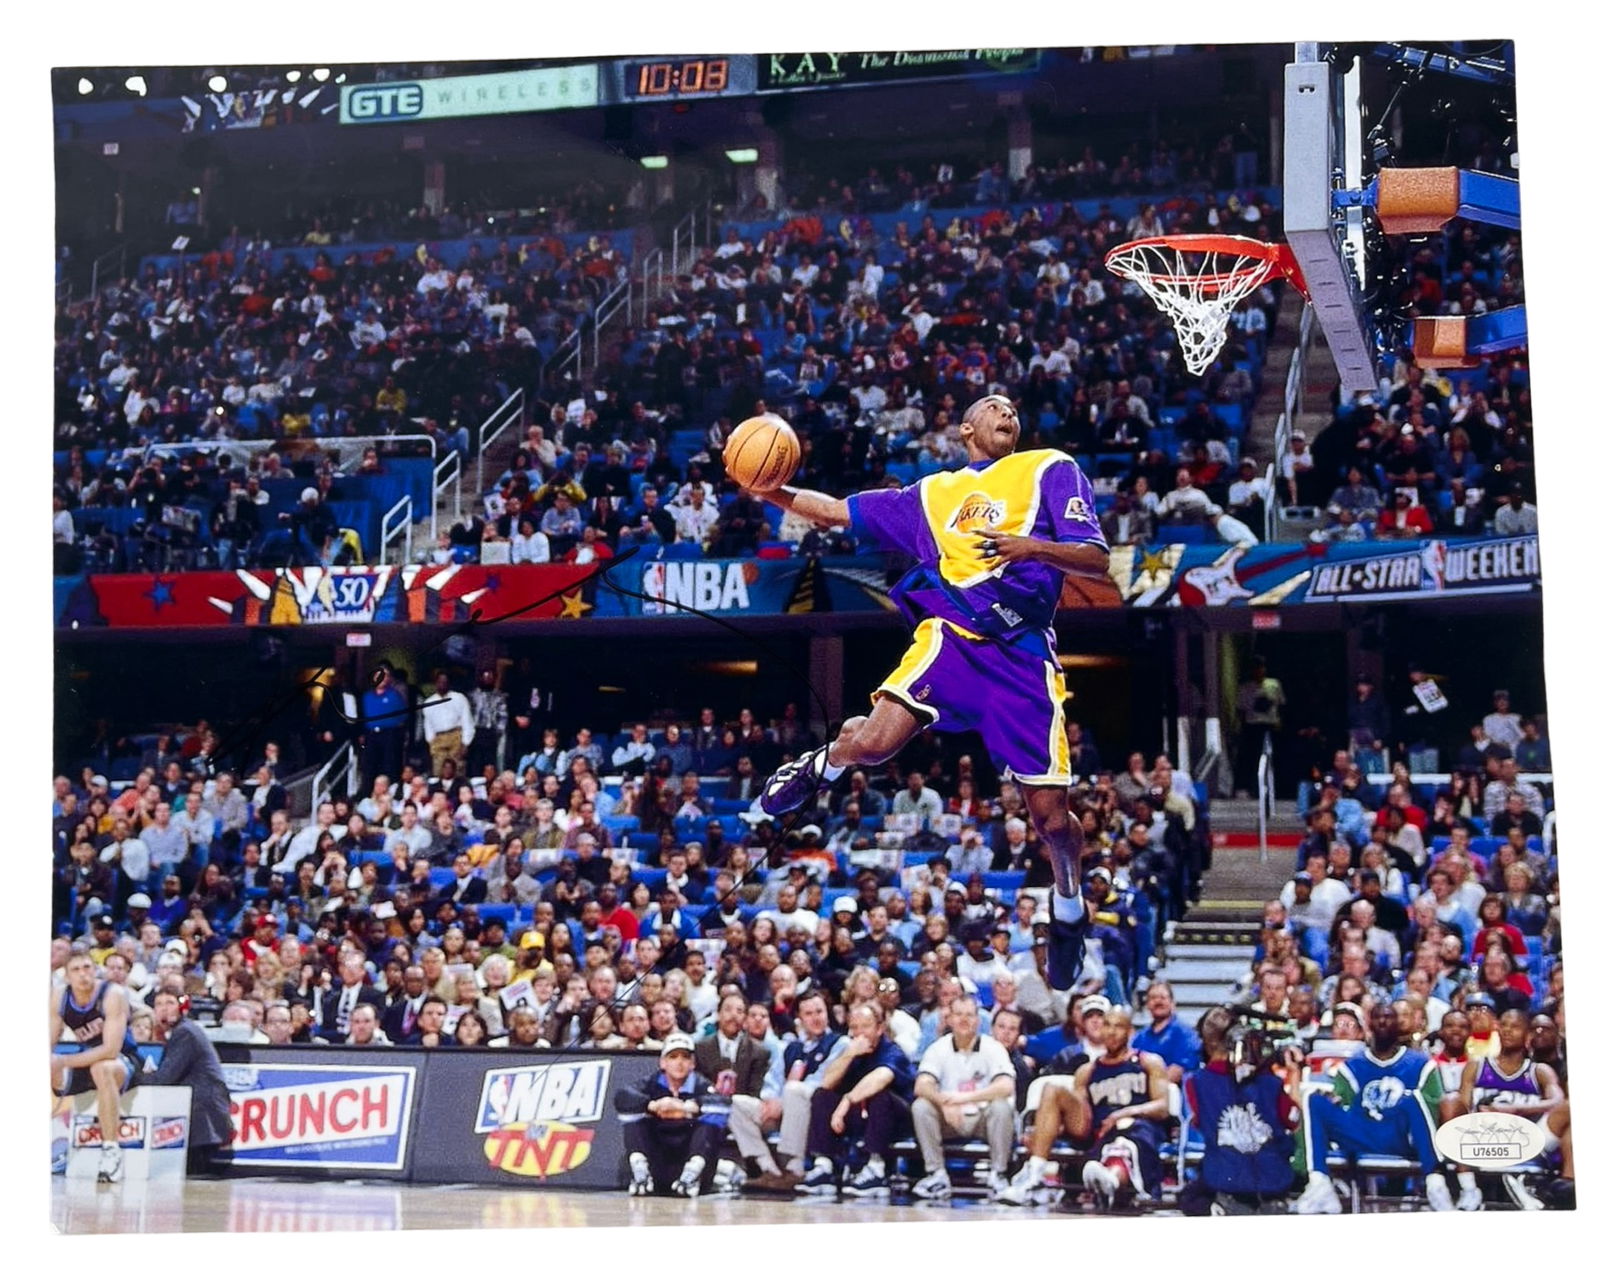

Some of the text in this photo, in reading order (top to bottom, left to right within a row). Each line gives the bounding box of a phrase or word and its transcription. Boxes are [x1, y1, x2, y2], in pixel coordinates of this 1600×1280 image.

[638, 60, 729, 96] 10:08
[770, 53, 844, 76] KAY
[352, 77, 592, 118] GTE WIRELESS
[1445, 539, 1538, 582] WEEKEN
[334, 576, 370, 609] 50
[665, 562, 750, 614] NBA
[501, 1066, 600, 1125] NBA
[488, 1128, 596, 1183] TNT
[1472, 1146, 1510, 1158] U76505
